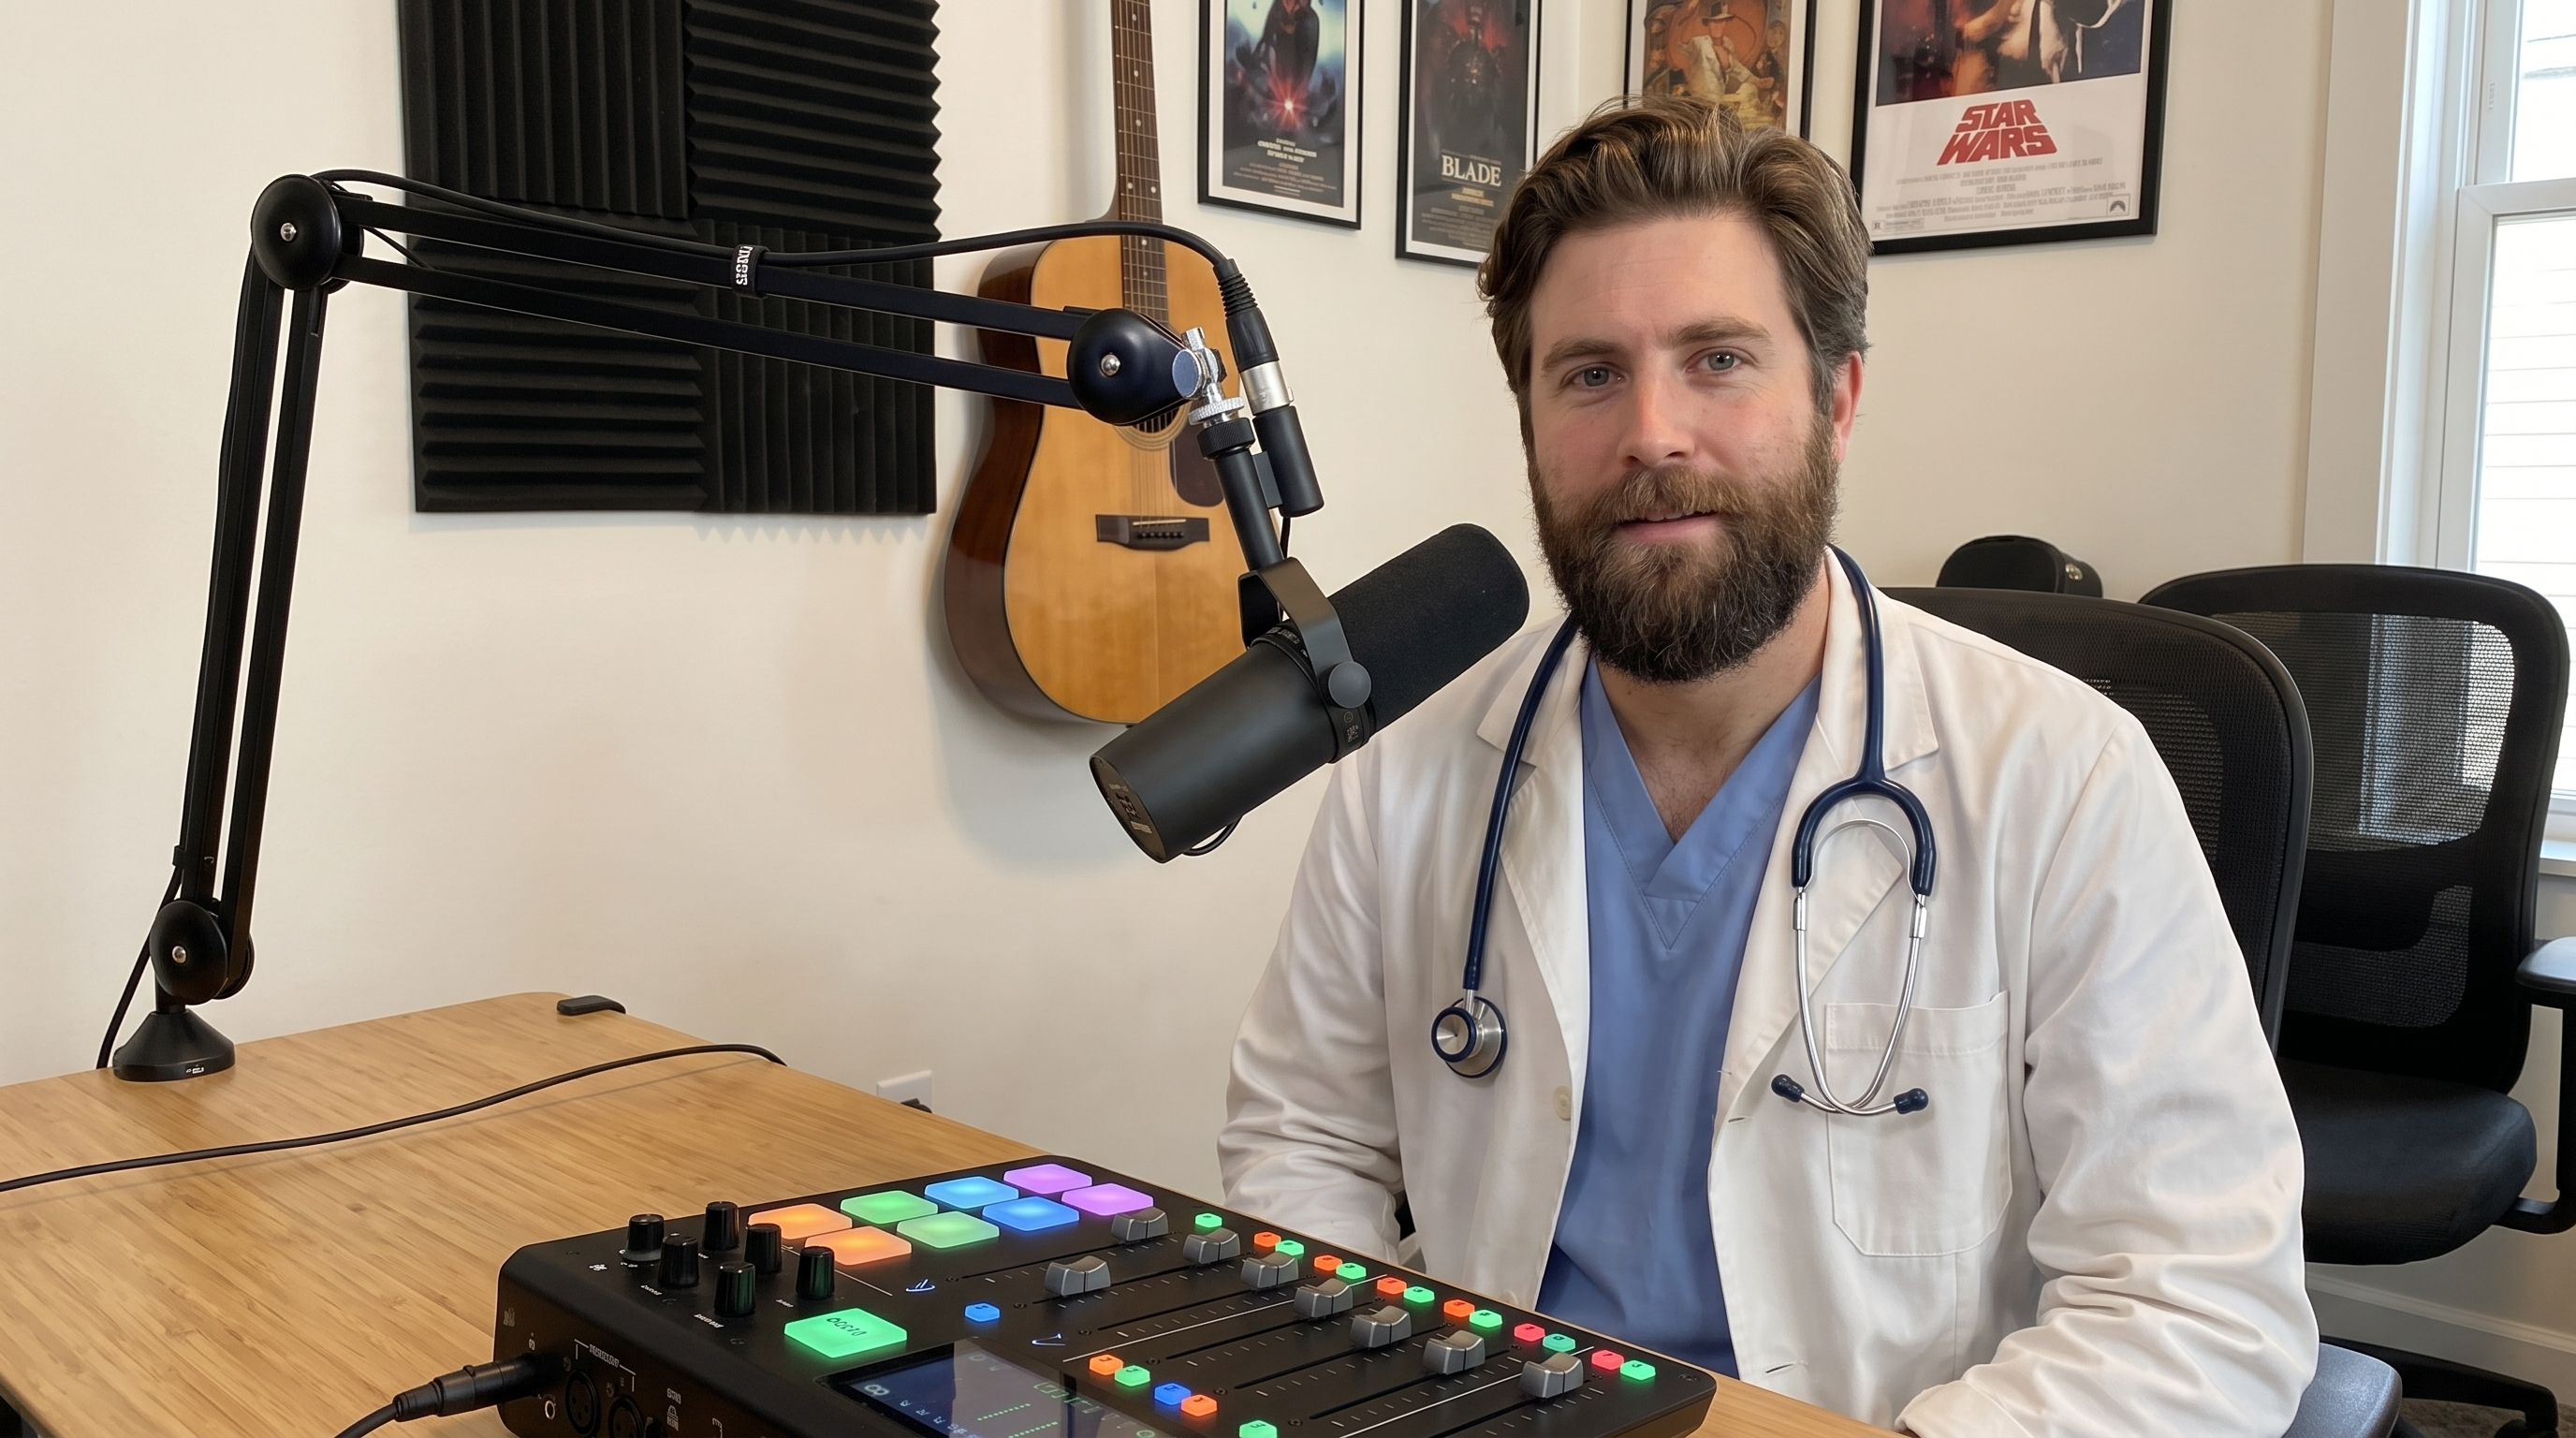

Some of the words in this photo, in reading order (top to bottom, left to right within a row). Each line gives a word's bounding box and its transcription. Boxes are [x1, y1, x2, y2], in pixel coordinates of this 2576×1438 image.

[1954, 99, 2042, 133] STAR
[1936, 125, 2057, 166] WARS
[1442, 154, 1501, 187] BLADE
